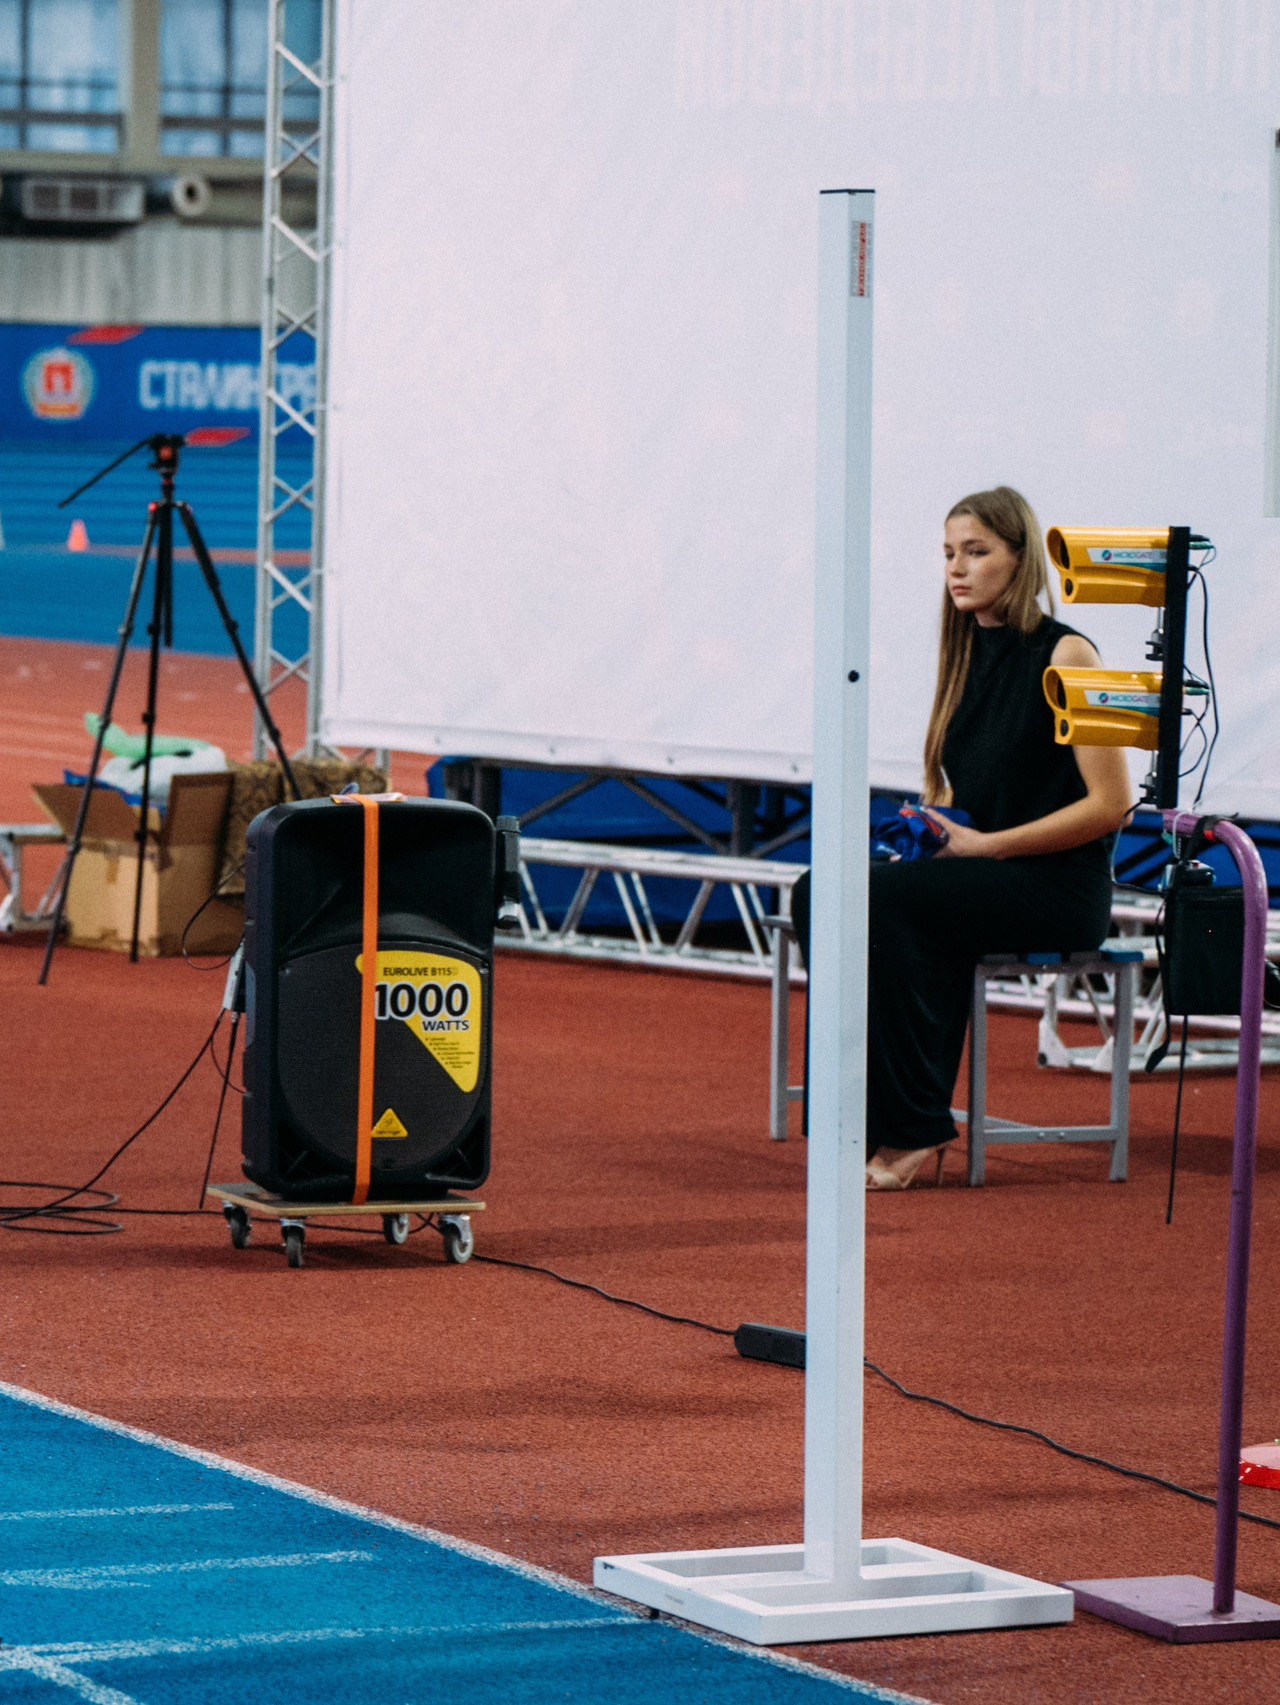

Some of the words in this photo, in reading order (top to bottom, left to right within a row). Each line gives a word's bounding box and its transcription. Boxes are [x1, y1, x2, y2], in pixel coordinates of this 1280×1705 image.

[383, 967, 428, 976] EUROLIVE
[375, 982, 469, 1018] 1000
[422, 1020, 469, 1031] WATTS
